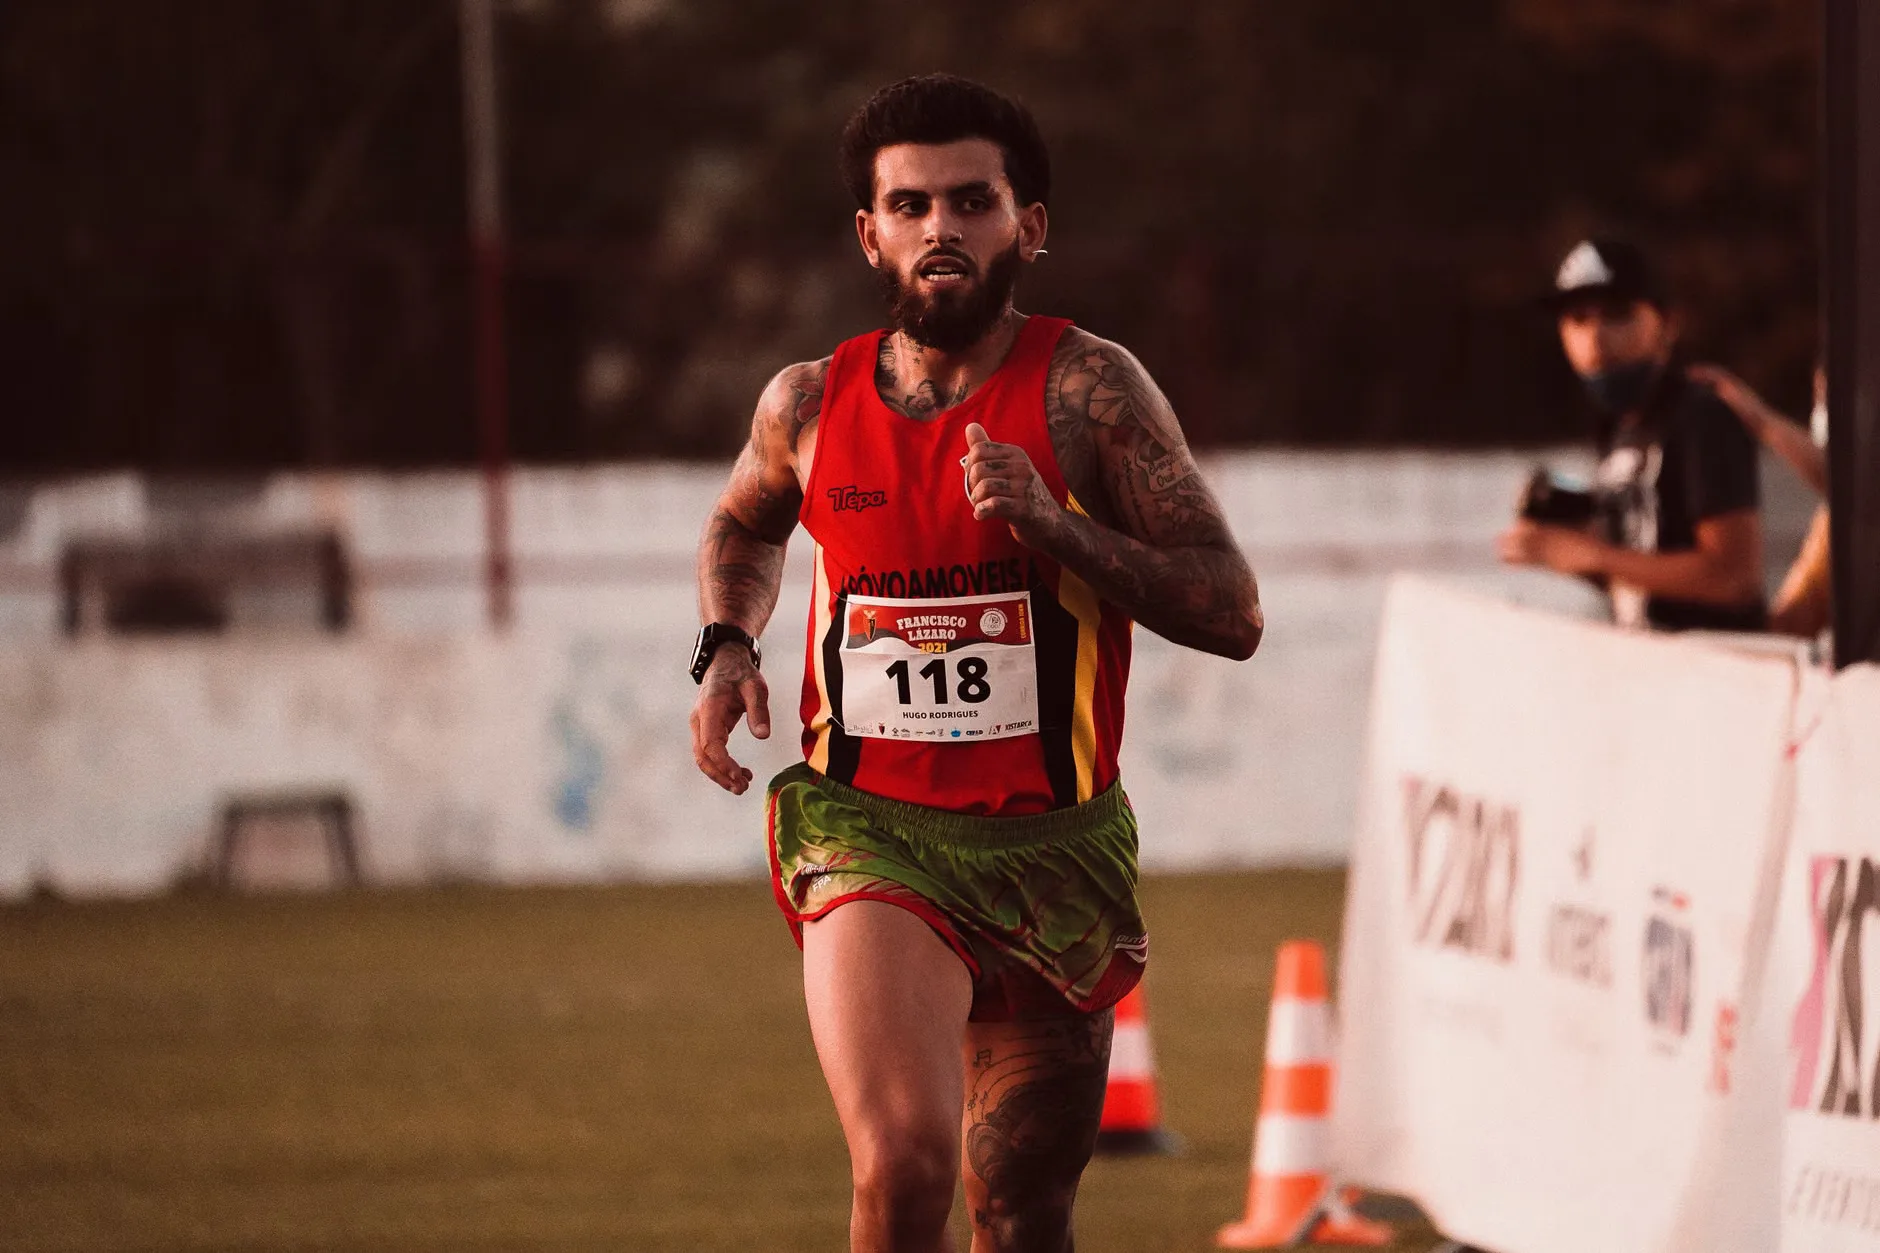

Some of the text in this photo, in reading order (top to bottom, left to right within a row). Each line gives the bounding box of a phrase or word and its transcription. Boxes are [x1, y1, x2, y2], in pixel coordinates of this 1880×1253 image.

[896, 615, 967, 629] FRANCISCO
[908, 628, 957, 641] LÁZARO
[918, 642, 947, 653] 2021
[885, 657, 991, 705] 118
[903, 710, 978, 719] HUGO RODRIGUES
[812, 876, 832, 892] FPA
